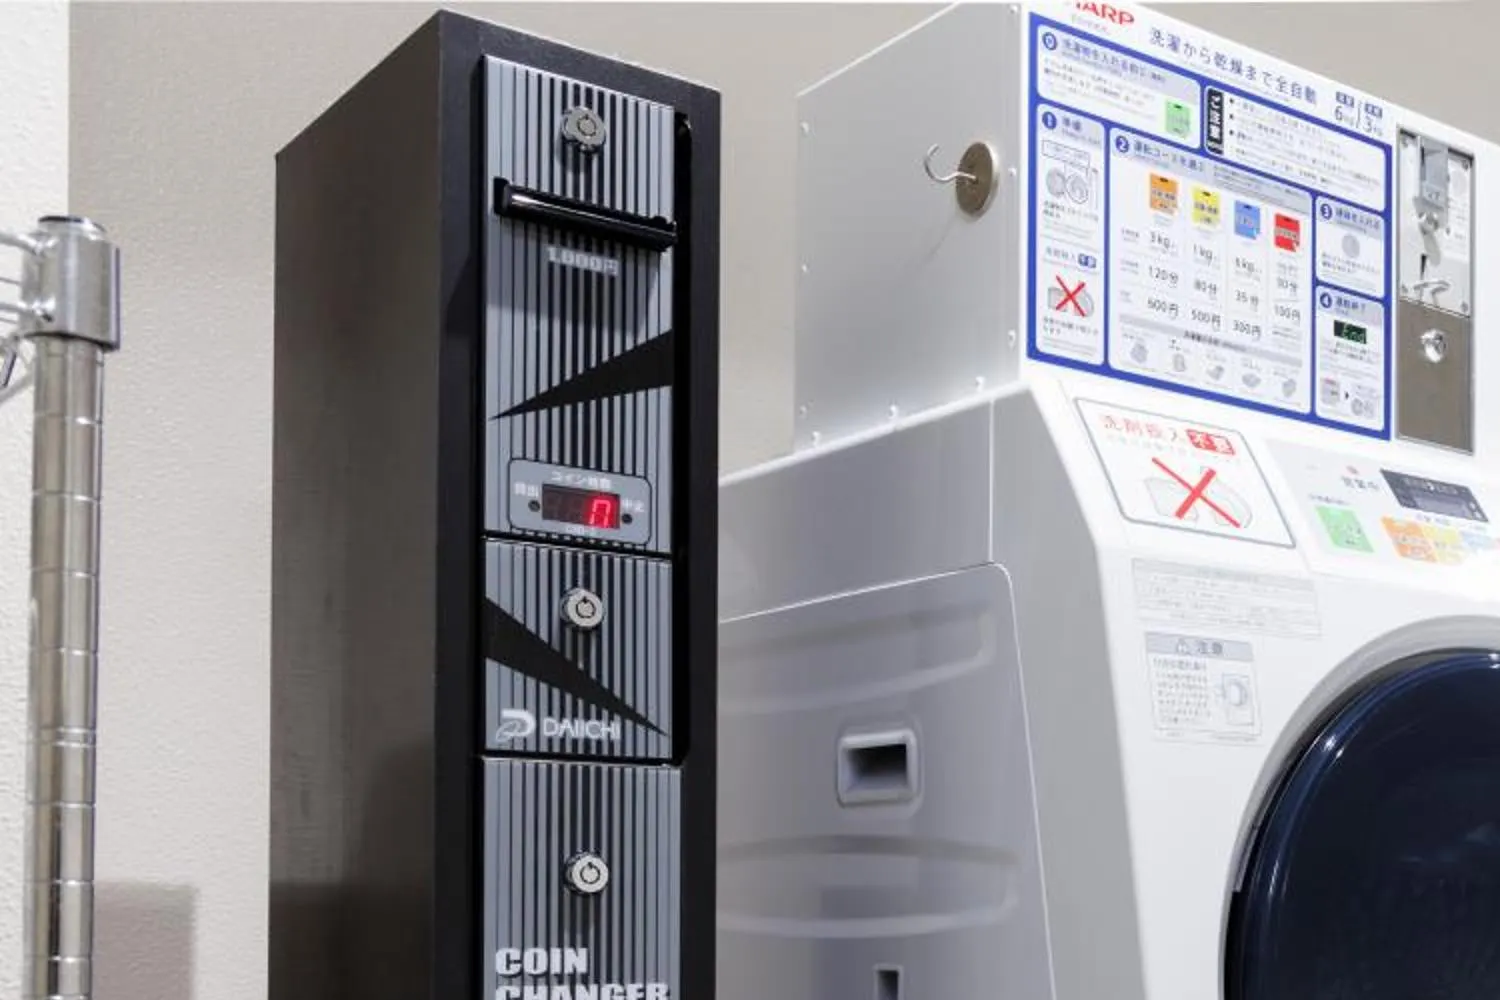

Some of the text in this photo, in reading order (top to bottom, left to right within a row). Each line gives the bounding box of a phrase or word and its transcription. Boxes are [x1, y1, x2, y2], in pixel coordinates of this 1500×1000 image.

[1151, 27, 1317, 104] 洗濯から乾燥まで全自動
[543, 717, 621, 741] DAIICHI
[495, 947, 588, 975] COIN
